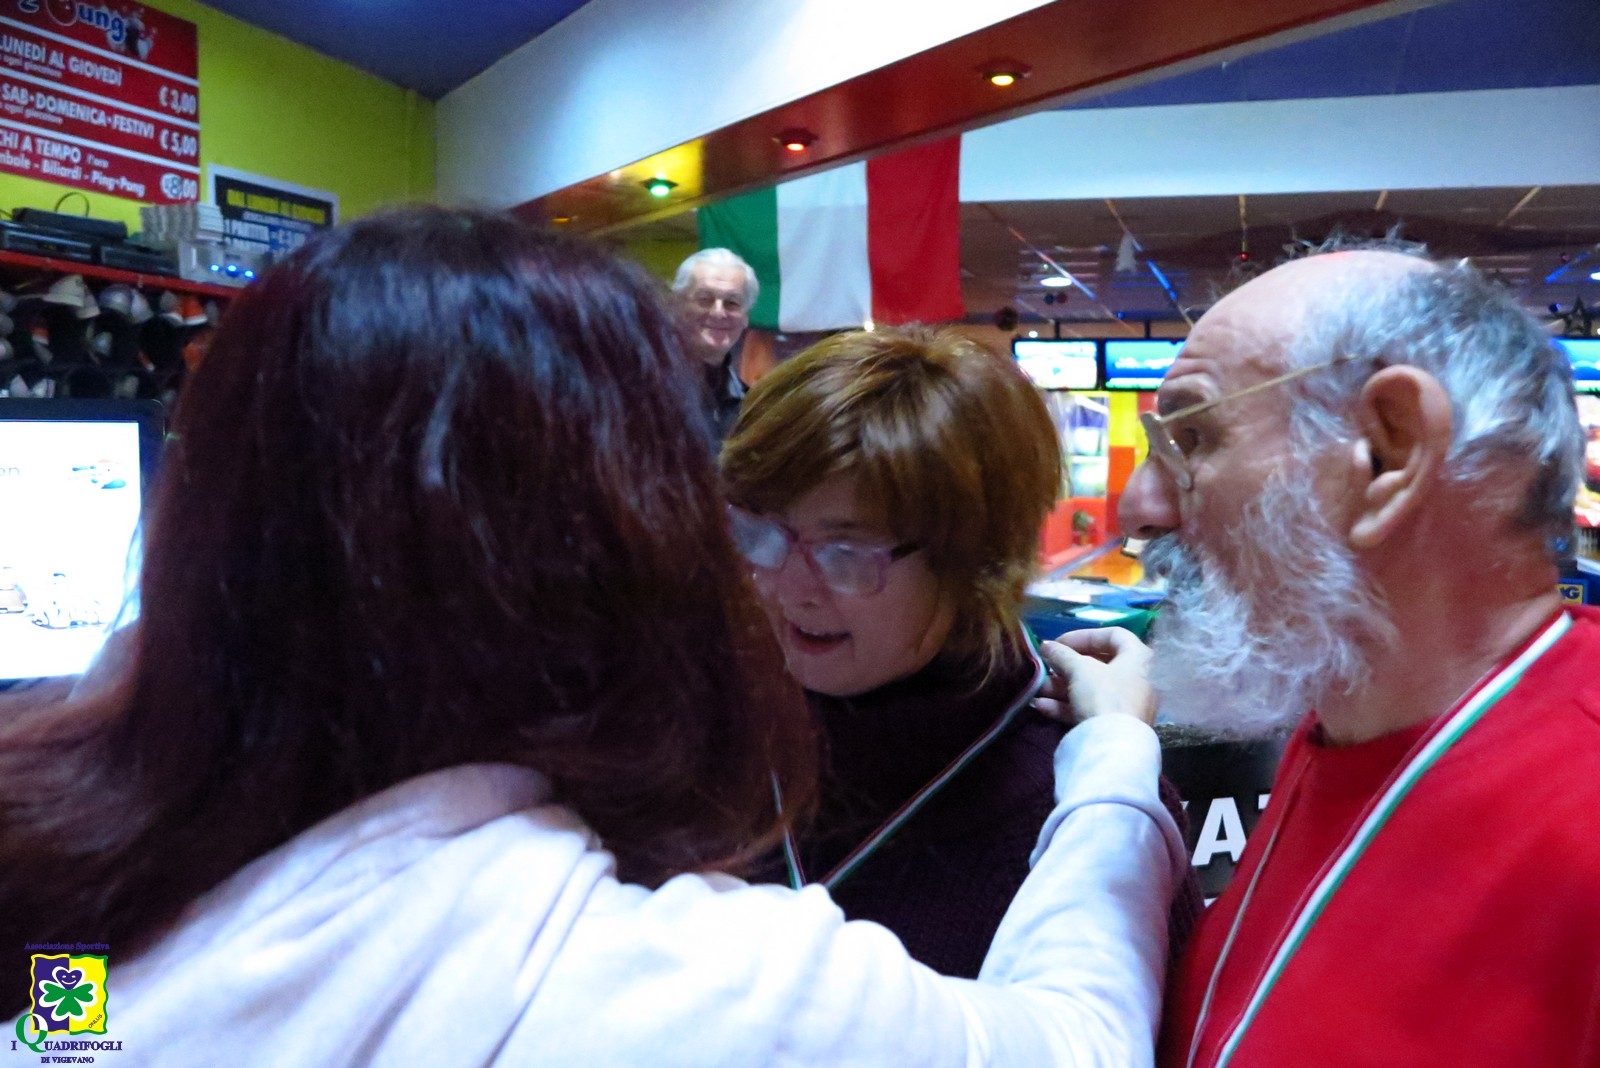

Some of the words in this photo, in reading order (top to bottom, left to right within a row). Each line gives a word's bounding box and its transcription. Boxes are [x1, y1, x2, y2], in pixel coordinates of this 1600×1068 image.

[48, 50, 66, 70] AL
[170, 89, 197, 115] 3,00
[21, 135, 33, 152] A
[35, 137, 82, 164] TEMPO
[171, 131, 197, 157] 5,00
